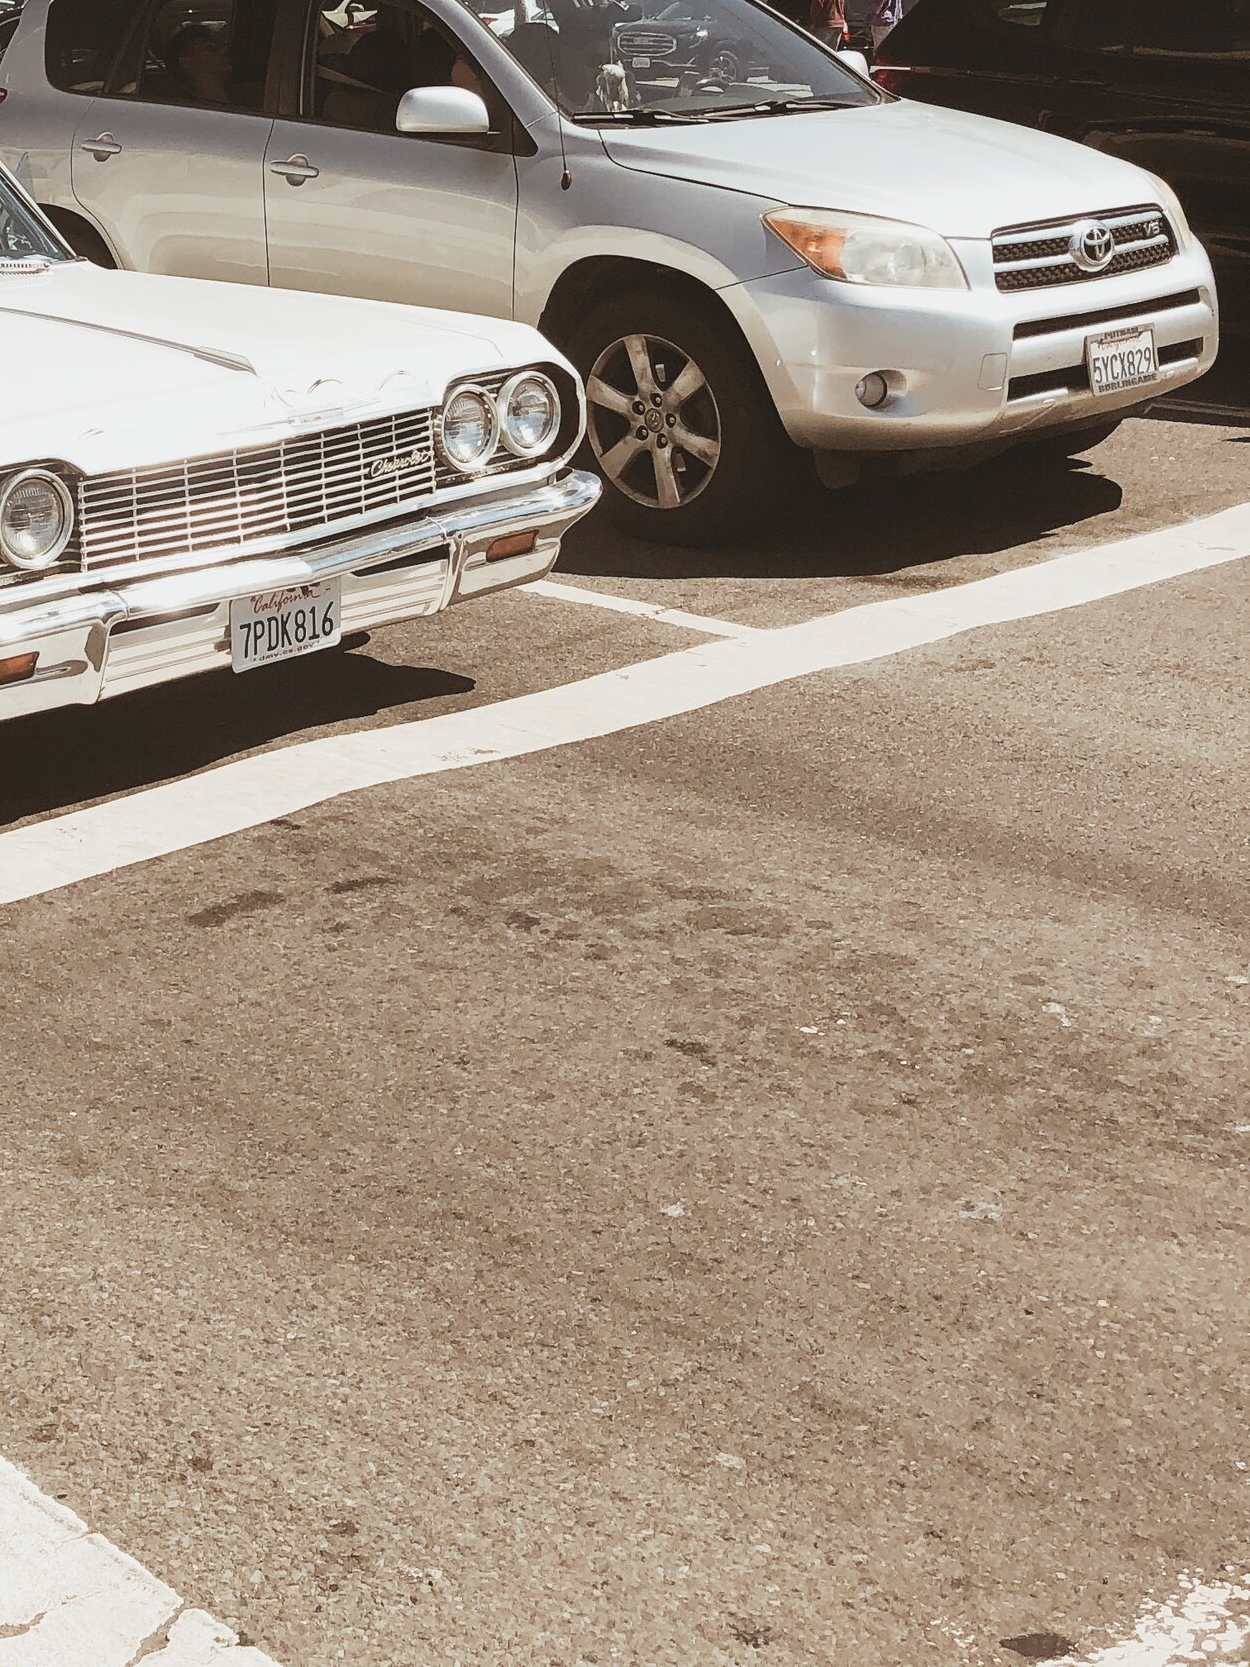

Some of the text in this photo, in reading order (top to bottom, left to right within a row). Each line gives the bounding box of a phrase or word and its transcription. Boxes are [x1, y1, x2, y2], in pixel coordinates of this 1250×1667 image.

[1104, 327, 1139, 340] PUTNAM
[1093, 346, 1151, 384] 5YCX829
[371, 449, 430, 477] Chevrolet
[239, 601, 334, 659] 7PDK816
